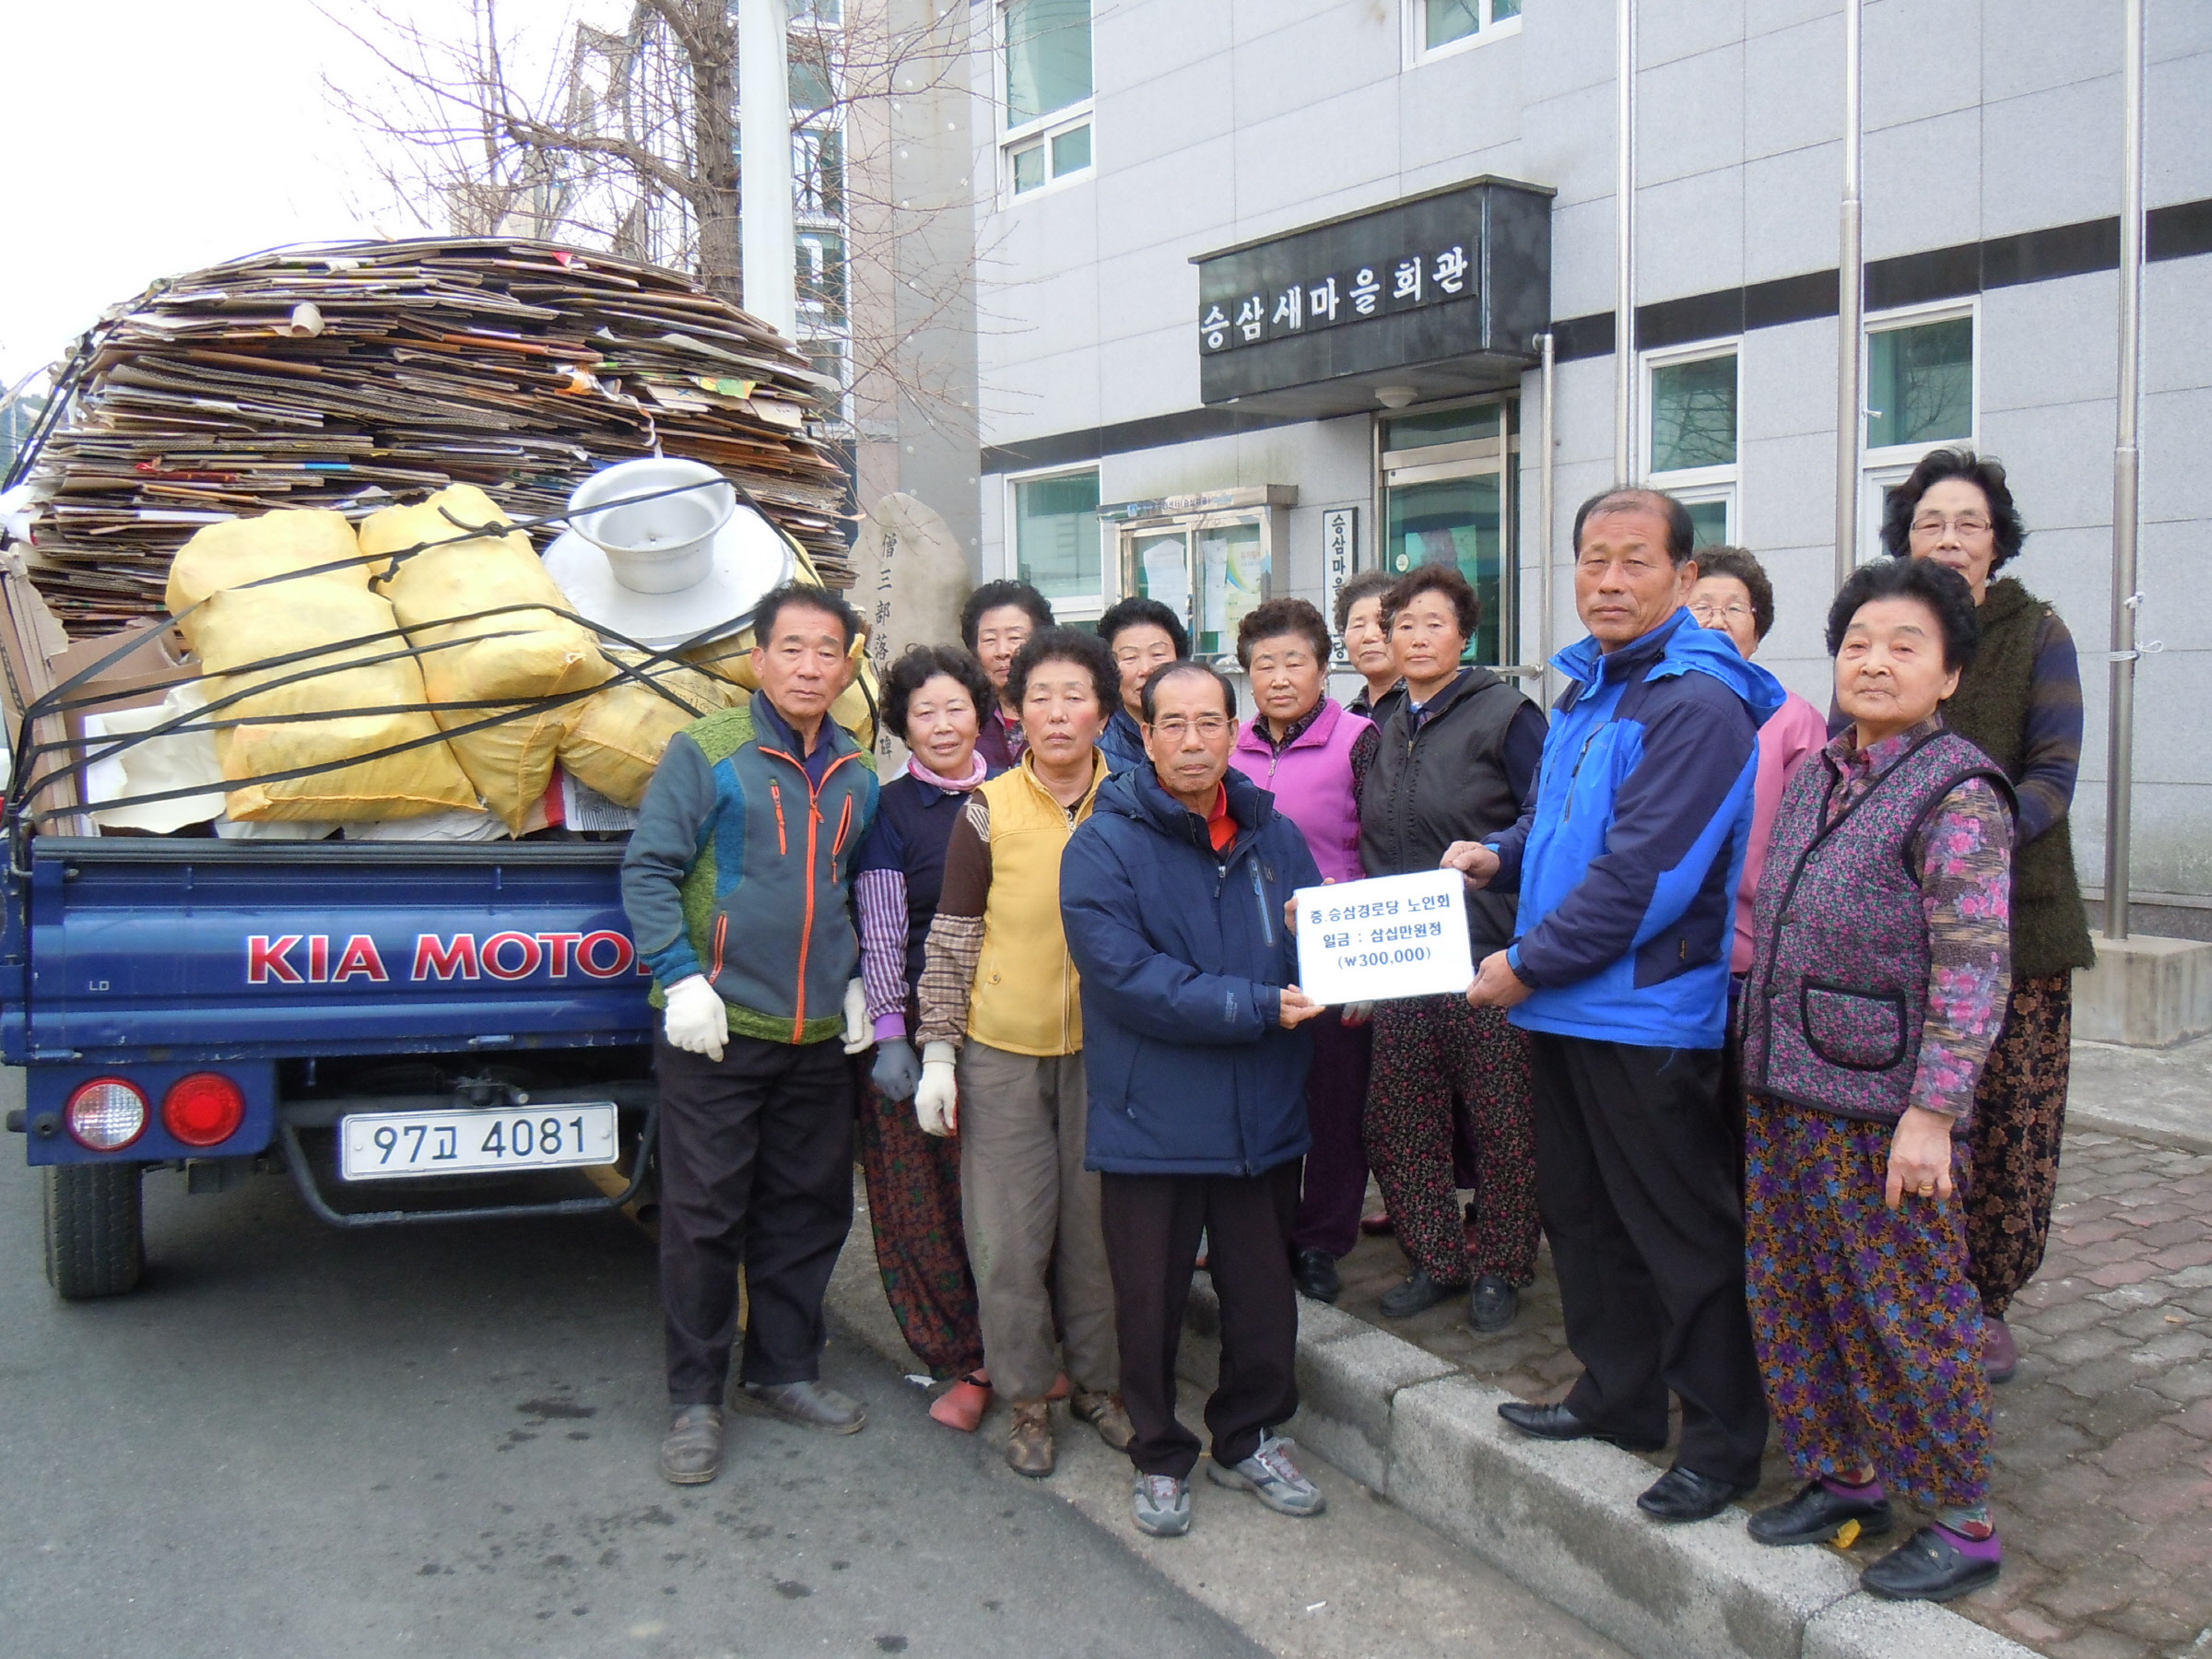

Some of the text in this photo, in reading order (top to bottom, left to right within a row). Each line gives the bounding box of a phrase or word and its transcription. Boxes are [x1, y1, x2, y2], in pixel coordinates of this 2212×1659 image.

[1201, 246, 1468, 348] 승삼새마을회관
[1408, 893, 1450, 912] 노인회
[247, 934, 390, 983] KIA
[1324, 933, 1349, 948] 일금
[1371, 922, 1441, 943] 삼십만원정
[373, 1115, 584, 1164] 97고 4081
